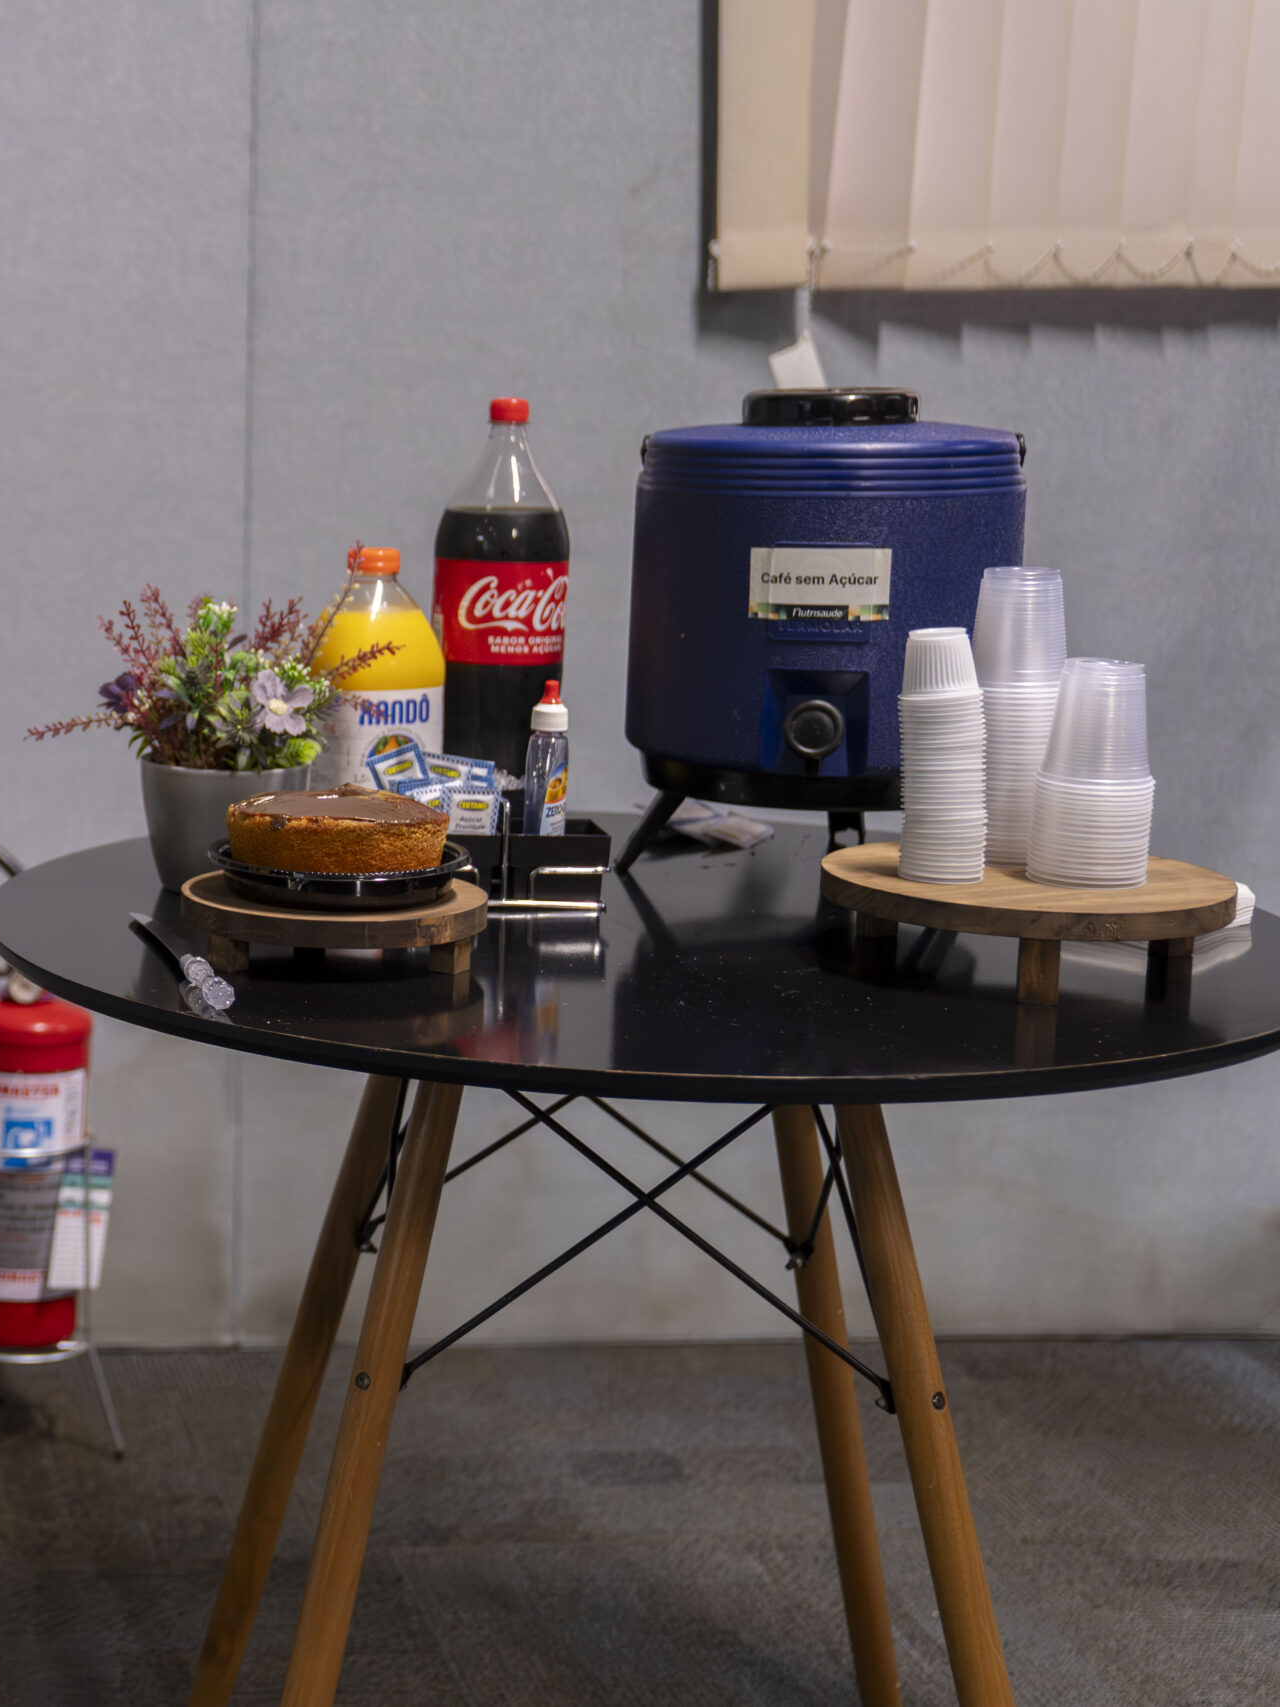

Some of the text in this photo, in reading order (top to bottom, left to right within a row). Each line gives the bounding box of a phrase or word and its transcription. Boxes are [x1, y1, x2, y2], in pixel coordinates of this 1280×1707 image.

[761, 572, 879, 588] Café sem Açúcar
[488, 635, 525, 645] SABOR
[359, 693, 430, 725] XANDÔ
